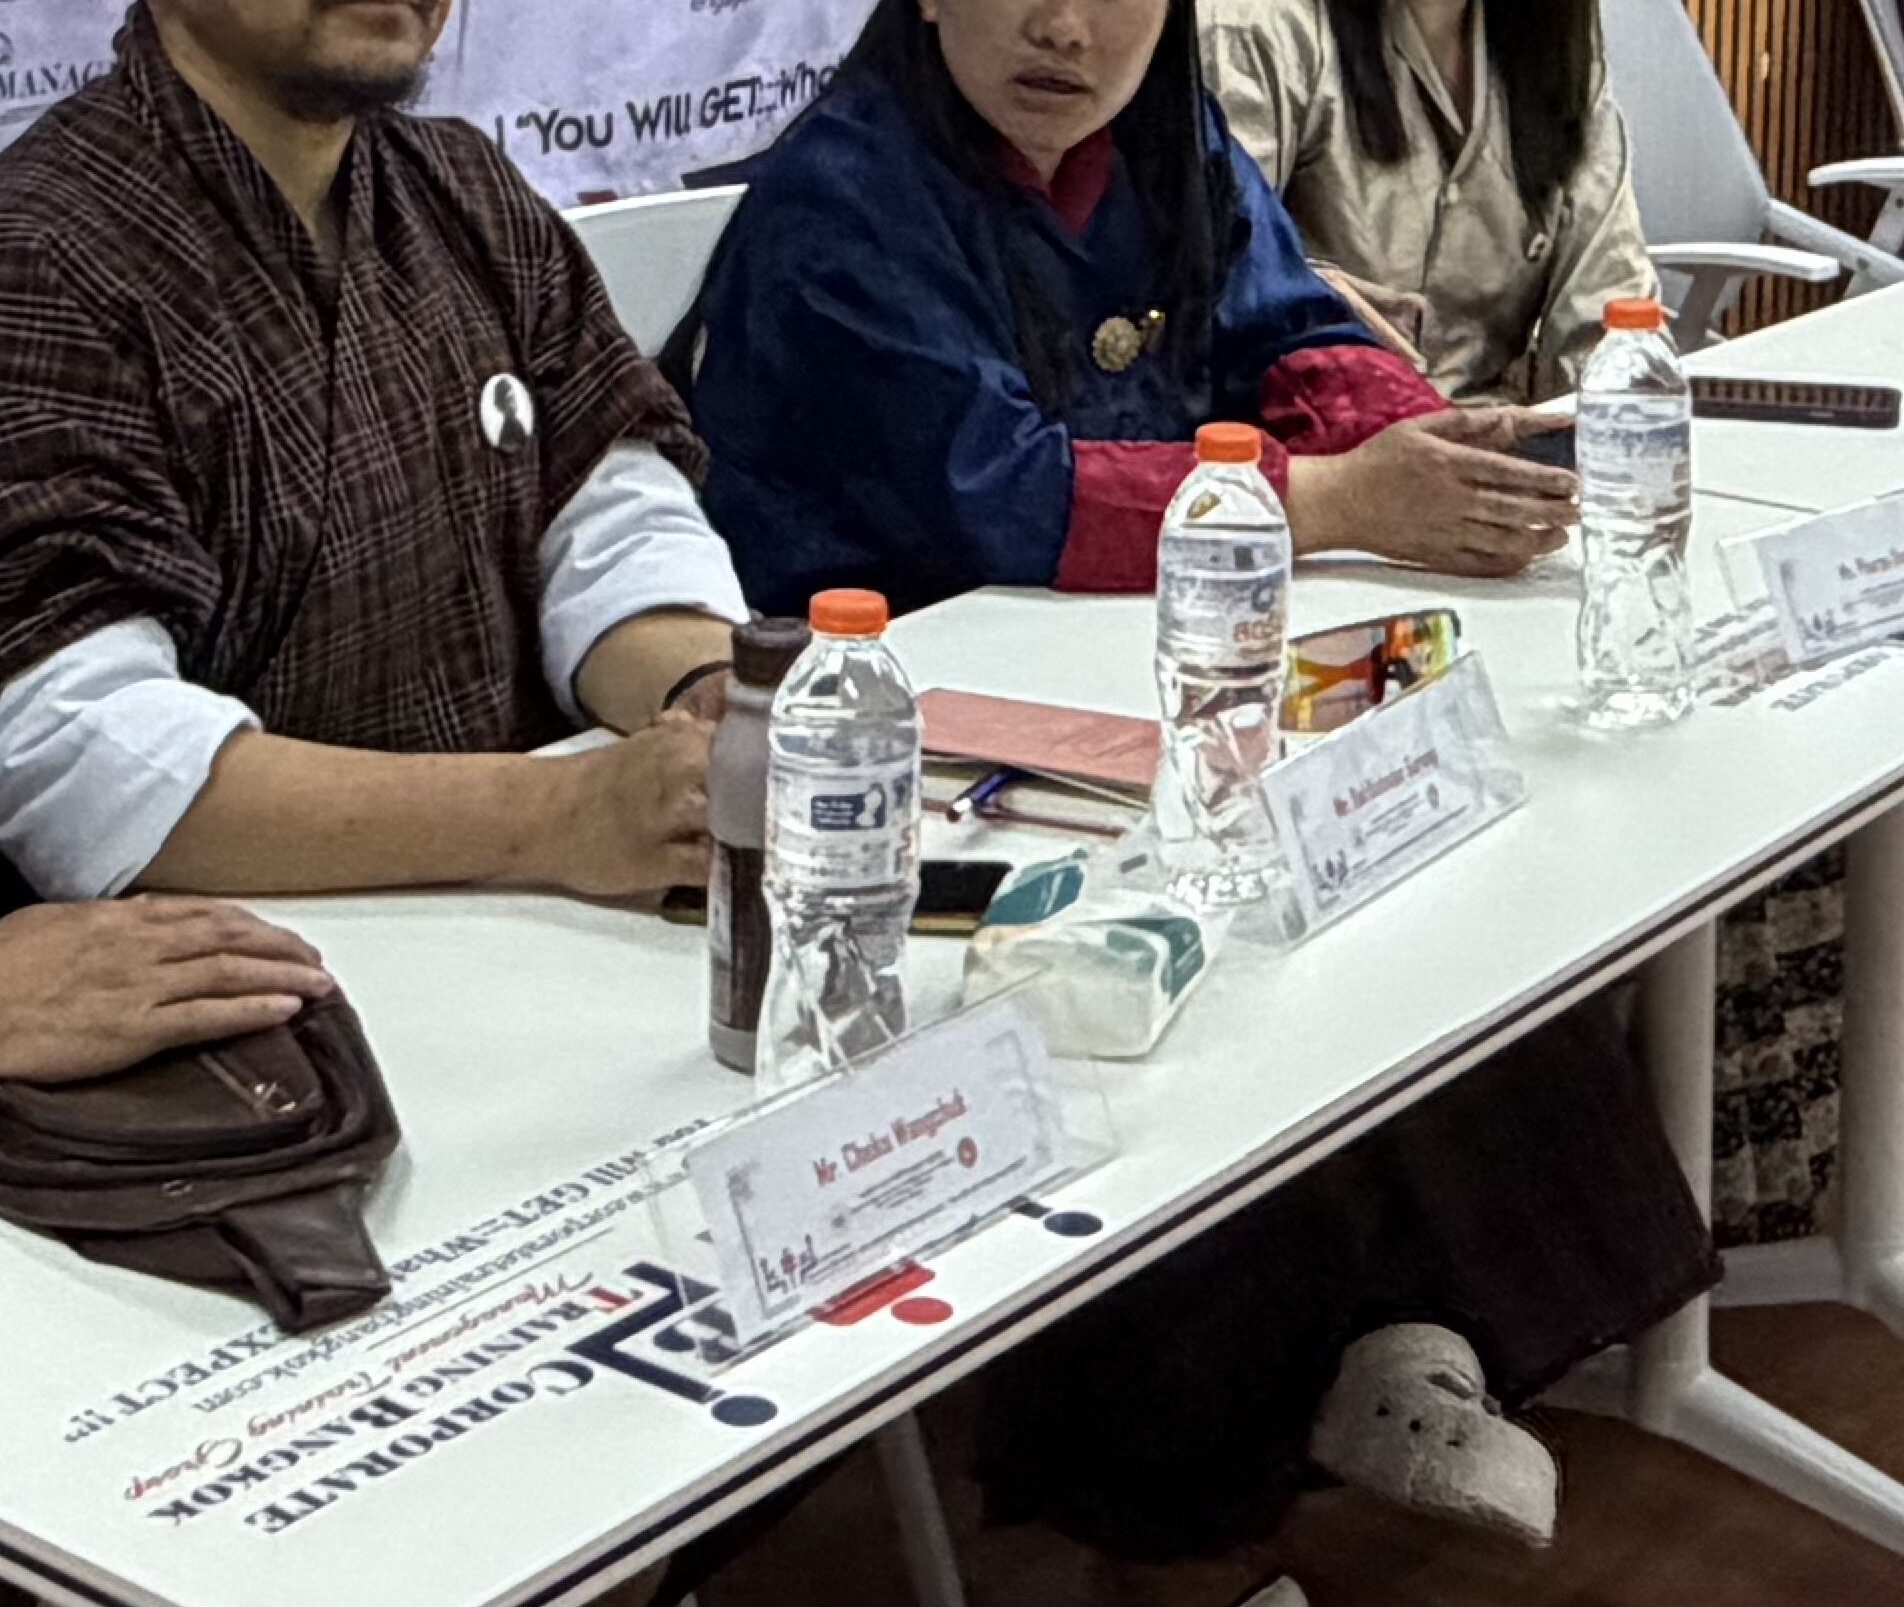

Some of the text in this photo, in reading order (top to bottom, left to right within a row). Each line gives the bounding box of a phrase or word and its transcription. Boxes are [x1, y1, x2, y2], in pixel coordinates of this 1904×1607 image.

[399, 1283, 643, 1408] TRAINING
[147, 1395, 413, 1526] BANGKOK
[245, 1358, 595, 1533] CORPORATE
